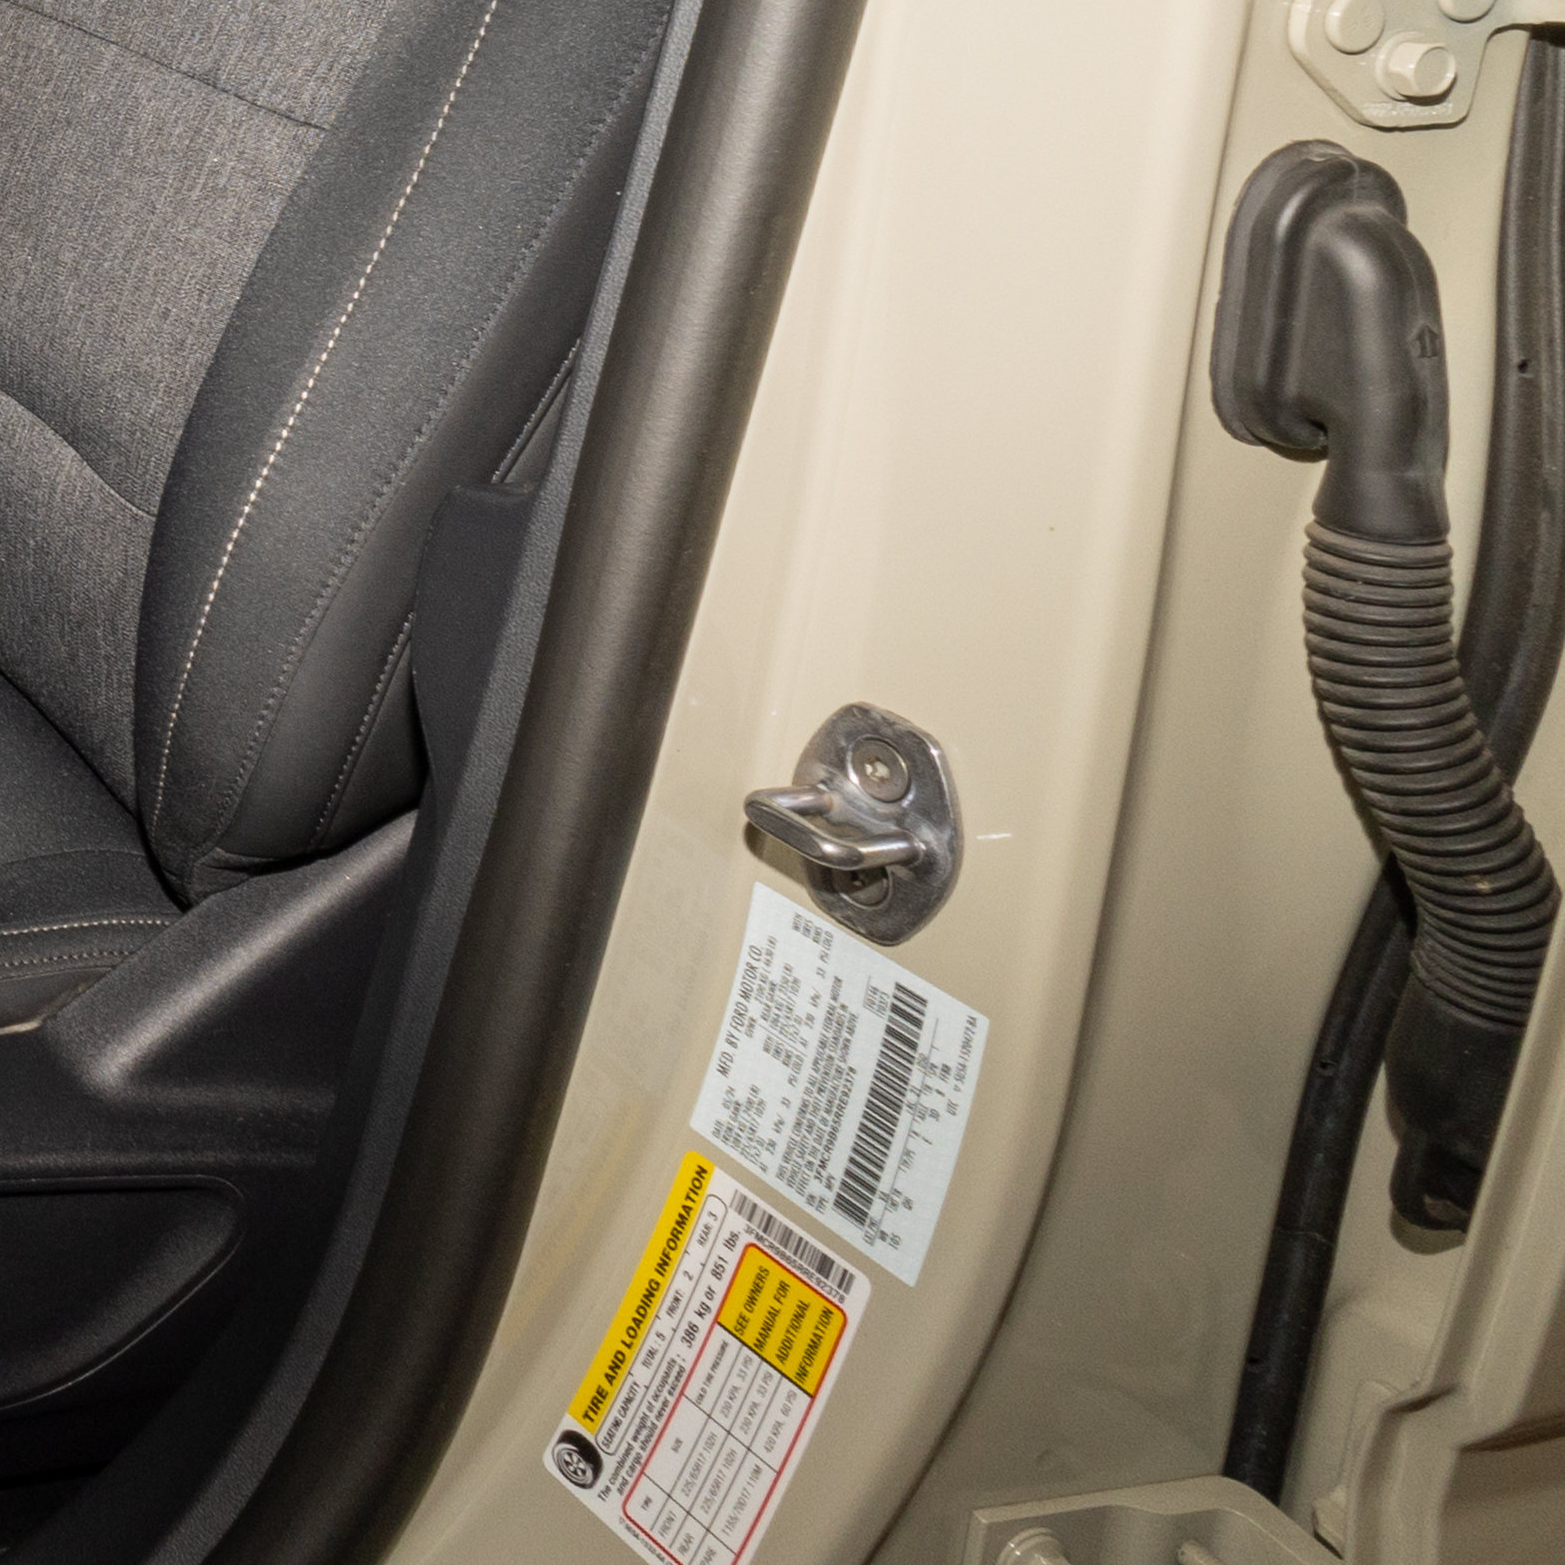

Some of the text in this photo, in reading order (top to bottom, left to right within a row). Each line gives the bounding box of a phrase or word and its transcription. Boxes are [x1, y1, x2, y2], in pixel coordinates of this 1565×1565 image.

[716, 944, 763, 1077] MFD. BY FORD MOTOR CO.
[582, 1165, 706, 1422] TIRE AND LOADING INFORMATION
[680, 1230, 740, 1348] 386 kg or 851 lbs.
[733, 1266, 769, 1335] SEE OWNERS
[753, 1279, 790, 1351] MANUAL FOR
[775, 1300, 809, 1364] ADDITIONAL
[794, 1306, 833, 1383] INFORMATION
[596, 1484, 612, 1501] The
[608, 1441, 634, 1485] combined
[631, 1411, 649, 1442] weight
[651, 1357, 677, 1402] occupants
[601, 1416, 622, 1454] SEATING
[617, 1381, 639, 1418] CAPACITY
[616, 1364, 685, 1496] and cargo should never exceed
